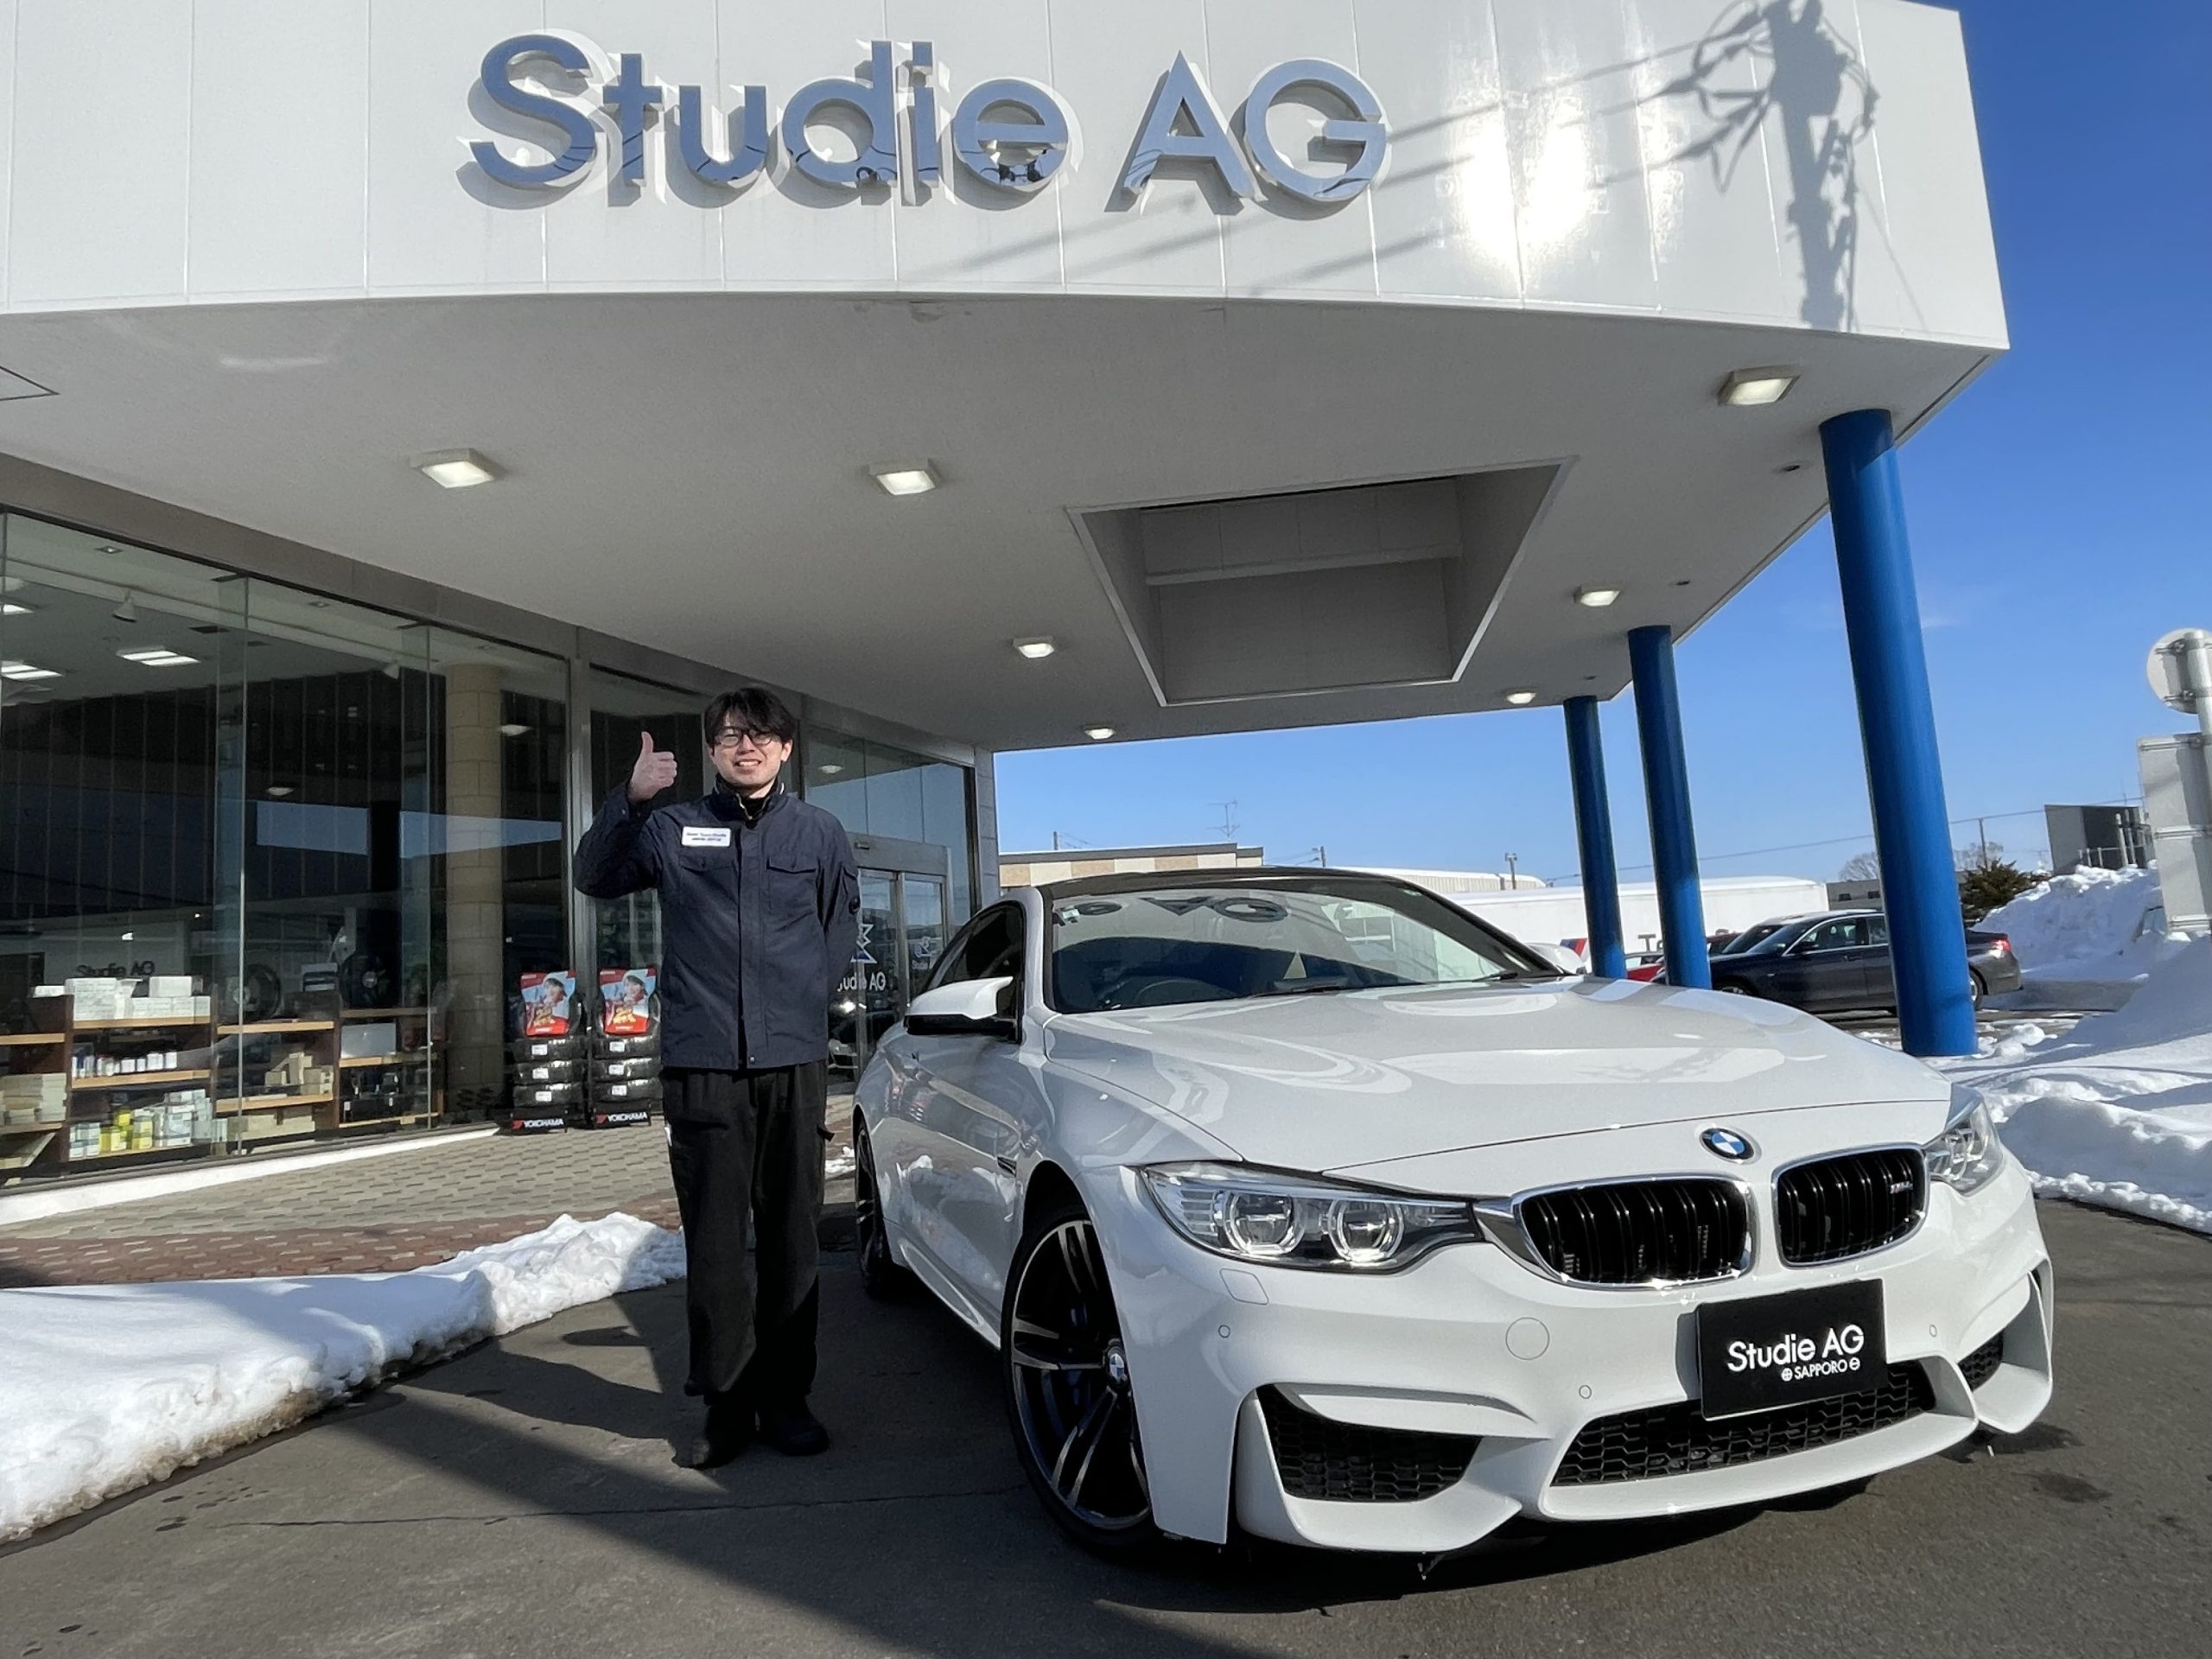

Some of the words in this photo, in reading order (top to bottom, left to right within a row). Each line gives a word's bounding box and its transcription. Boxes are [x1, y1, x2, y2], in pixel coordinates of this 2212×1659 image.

[468, 33, 1071, 204] Studie
[1121, 49, 1386, 204] AG
[869, 971, 887, 991] AG
[523, 1118, 564, 1128] YOKOHAMA
[607, 1111, 648, 1122] YOKOHAMA
[1727, 1333, 1816, 1372] Studie
[1822, 1324, 1865, 1358] AG
[1794, 1358, 1848, 1380] SAPPORO
